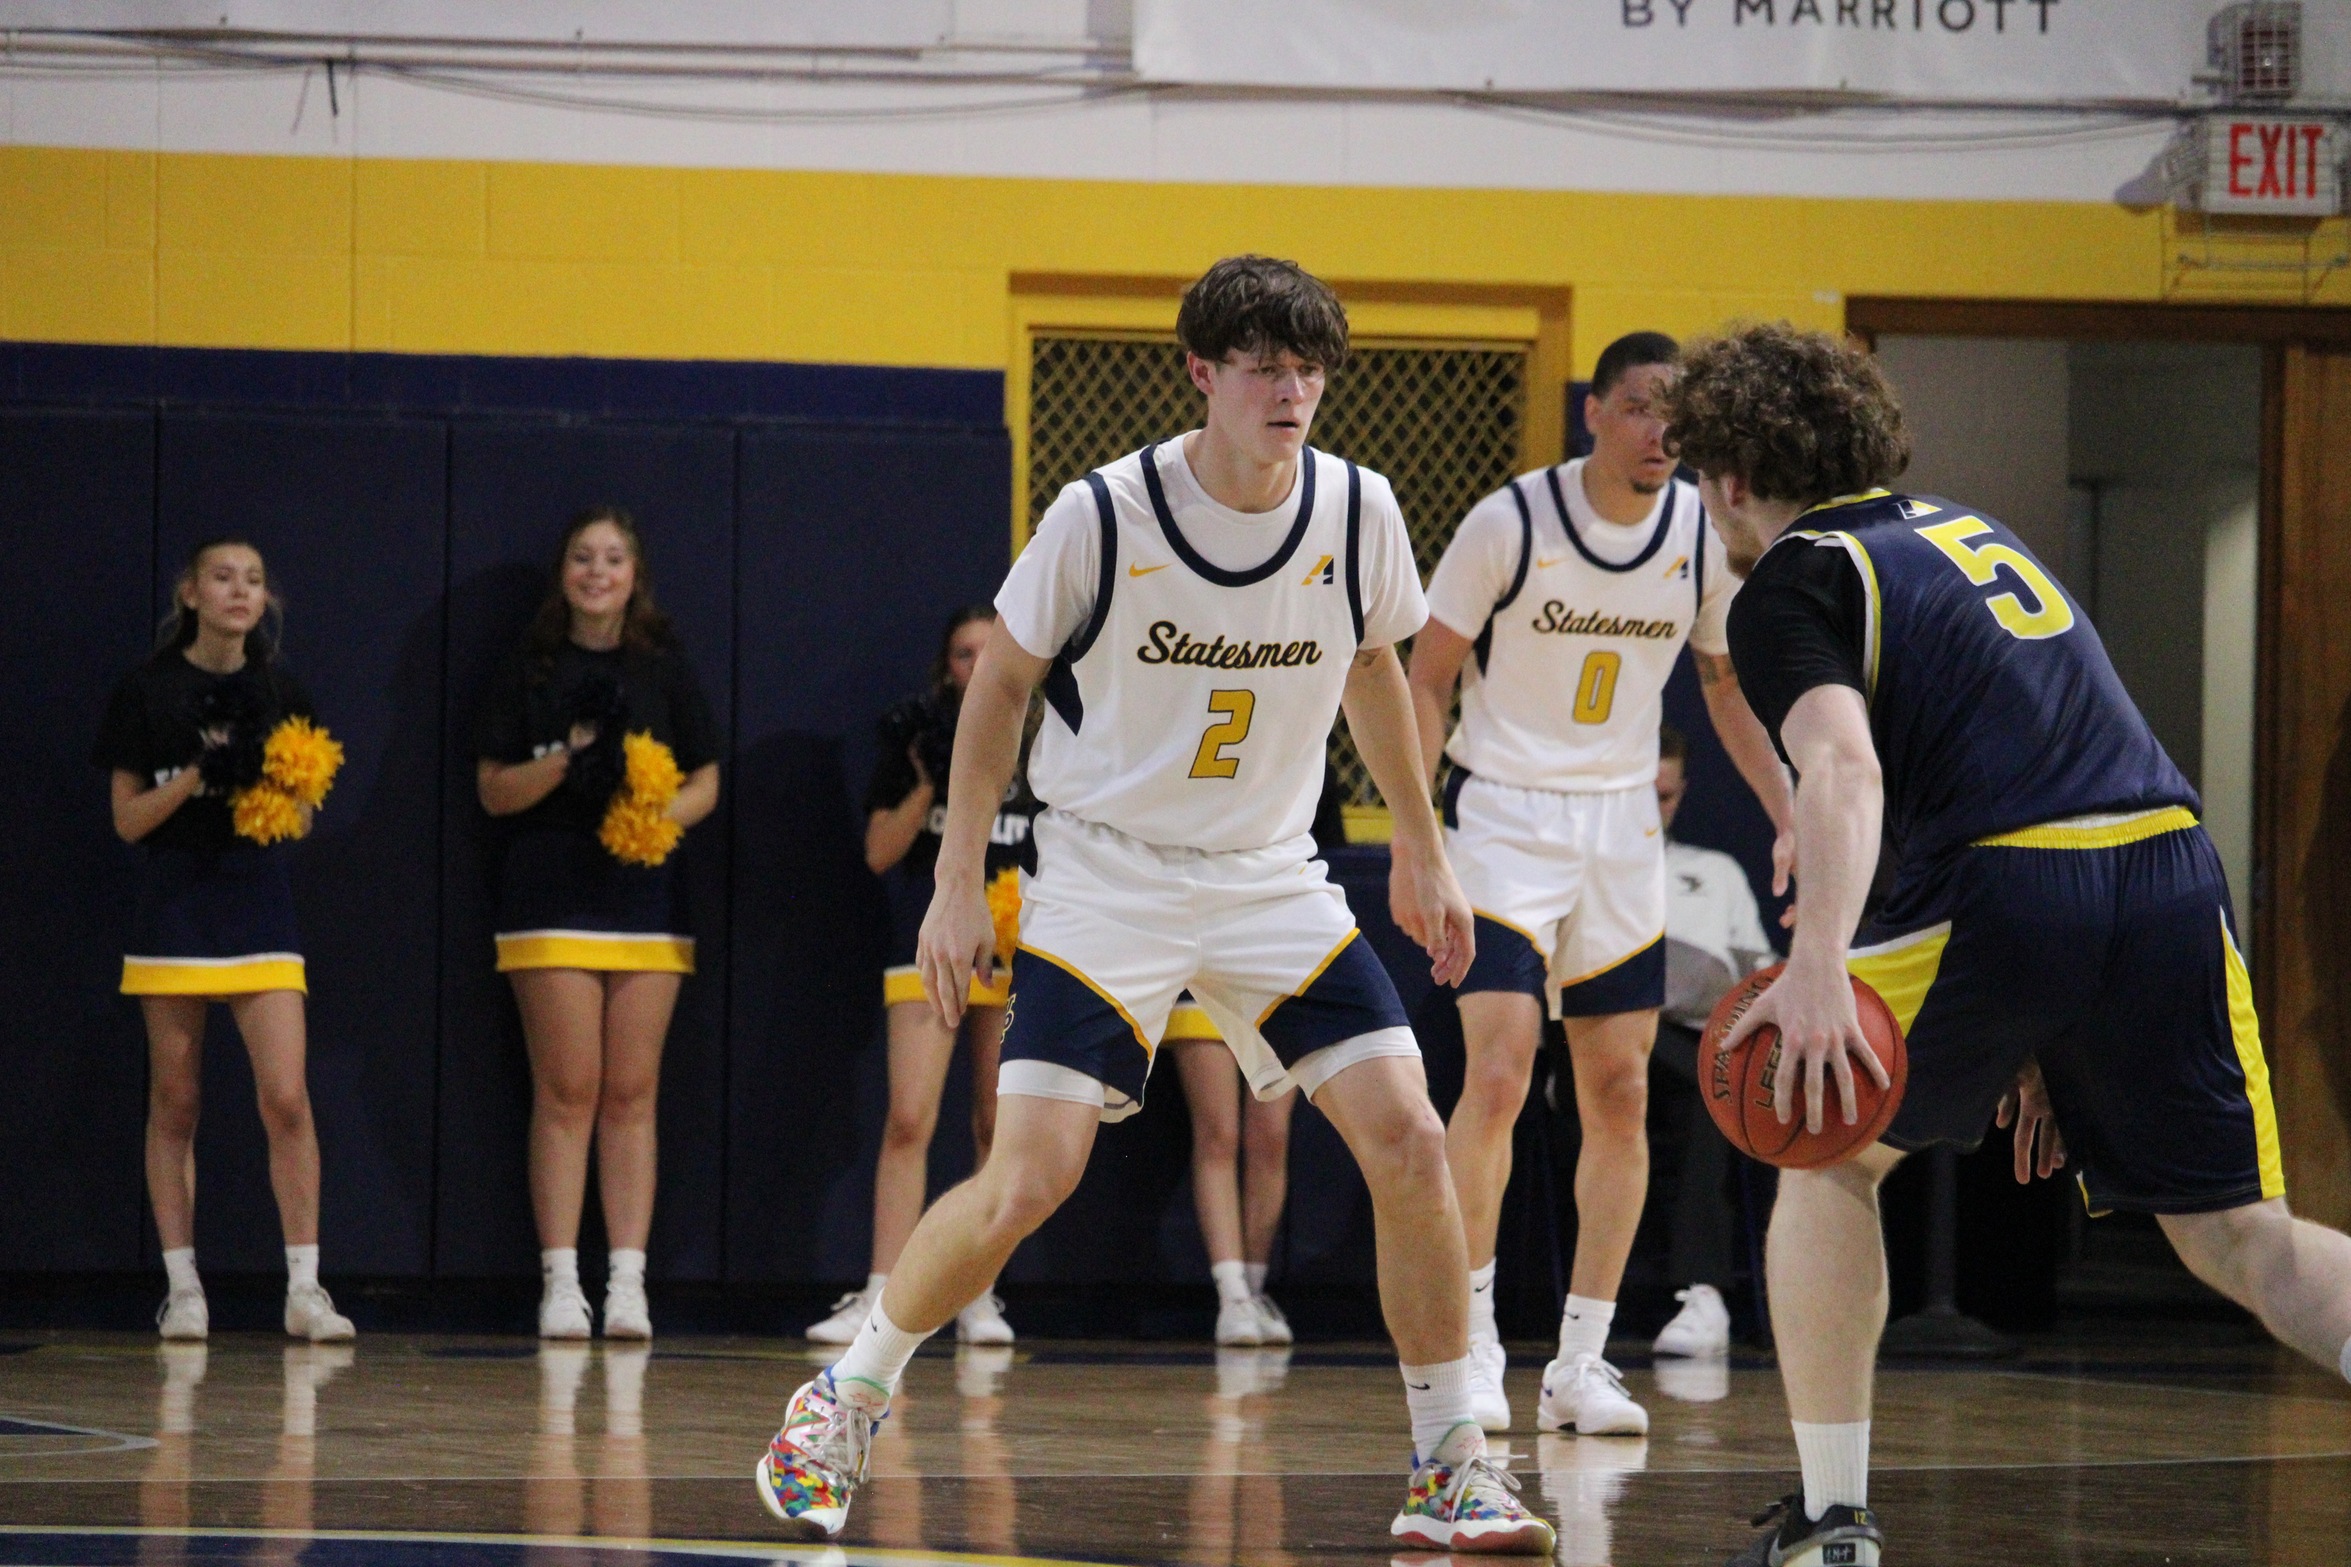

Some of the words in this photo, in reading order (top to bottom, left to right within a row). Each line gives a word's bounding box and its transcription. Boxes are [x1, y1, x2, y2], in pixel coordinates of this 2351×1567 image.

[1622, 0, 1690, 28] BY
[1733, 0, 2060, 35] MARRIOTT
[2228, 122, 2324, 200] EXIT
[1914, 515, 2075, 640] 5
[1136, 619, 1322, 669] Statesmen
[1531, 599, 1677, 640] Statesmen
[1571, 650, 1622, 726] 0
[1187, 688, 1256, 780] 2
